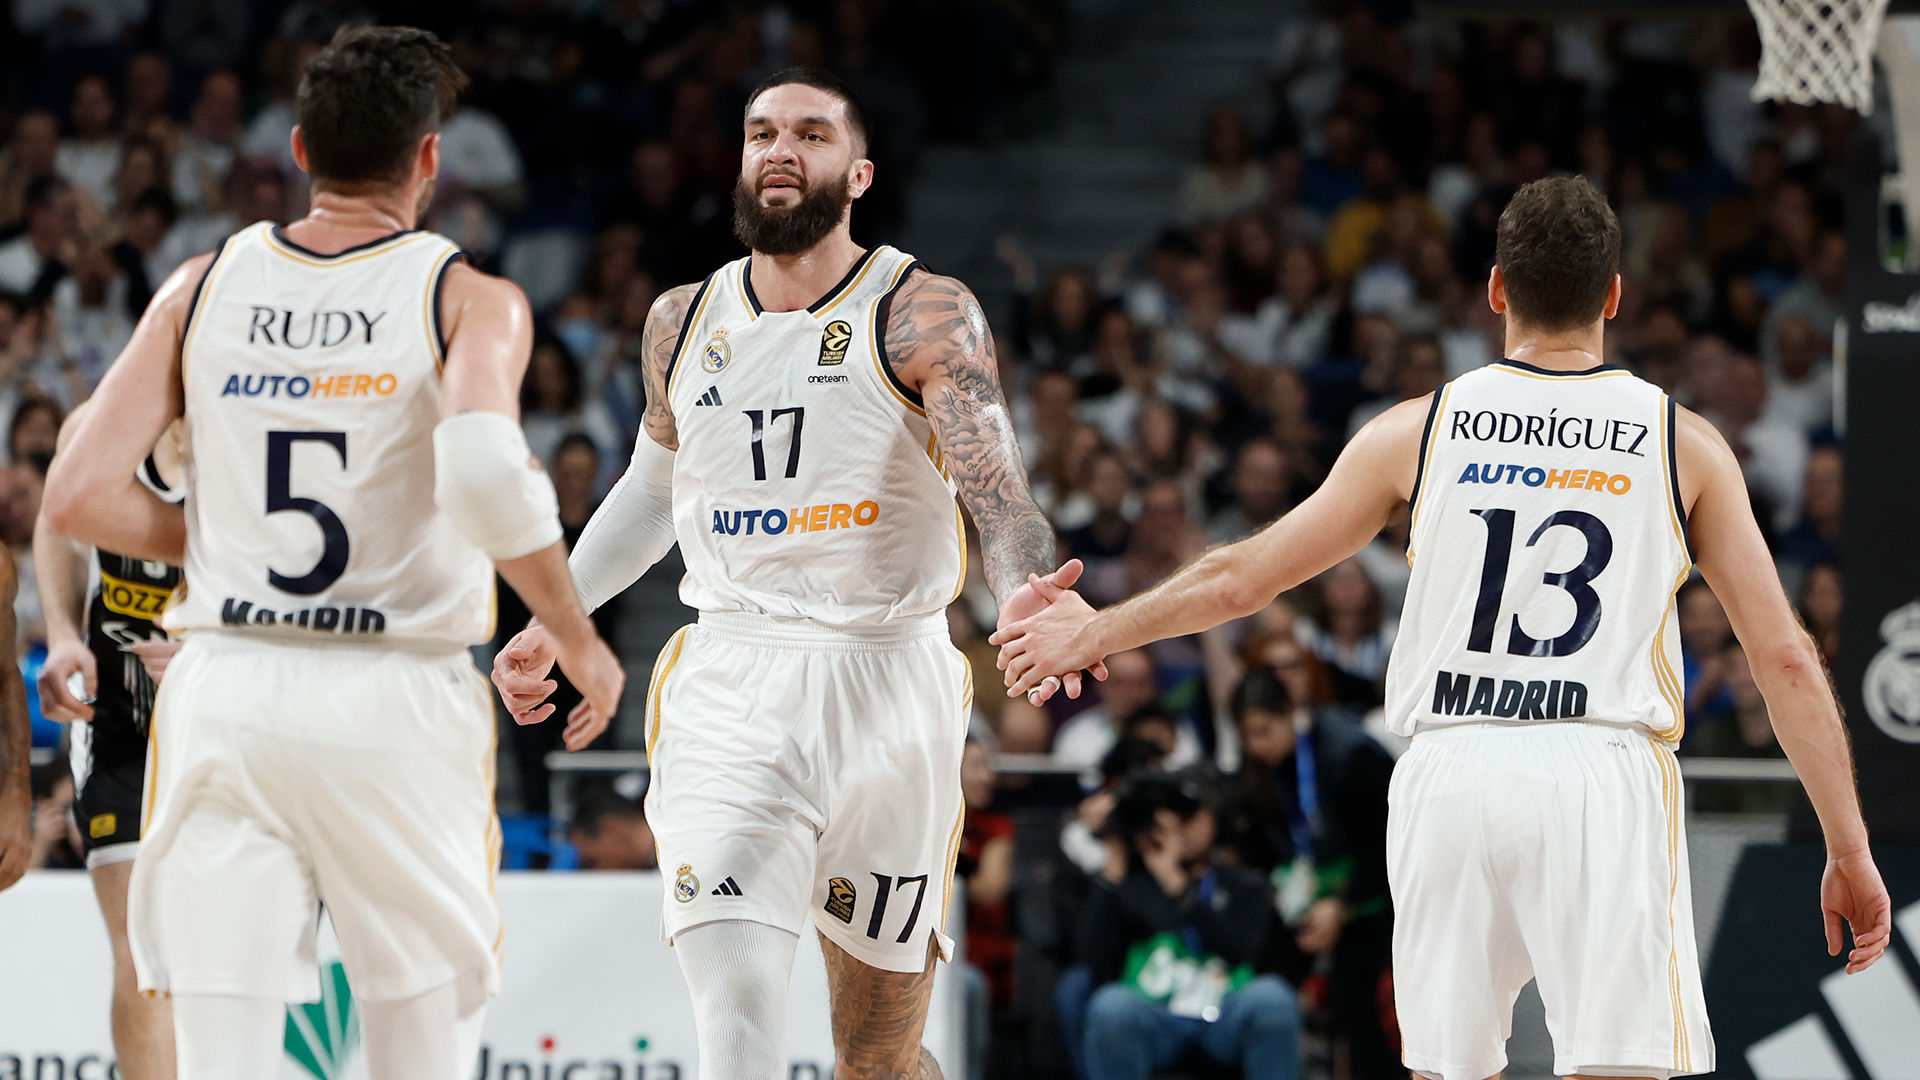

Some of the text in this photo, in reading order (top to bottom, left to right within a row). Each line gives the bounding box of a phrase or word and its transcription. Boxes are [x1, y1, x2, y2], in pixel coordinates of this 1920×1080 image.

[248, 306, 388, 348] RUDY
[221, 373, 399, 399] AUTOHERO
[807, 374, 848, 384] oneteam
[742, 406, 805, 481] 17
[1450, 408, 1649, 457] RODRÍGUEZ
[1457, 463, 1632, 496] AUTOHERO
[265, 430, 350, 597] 5
[712, 500, 880, 536] AUTOHERO
[1466, 508, 1614, 658] 13
[1431, 670, 1588, 721] MADRID
[866, 871, 928, 943] 17
